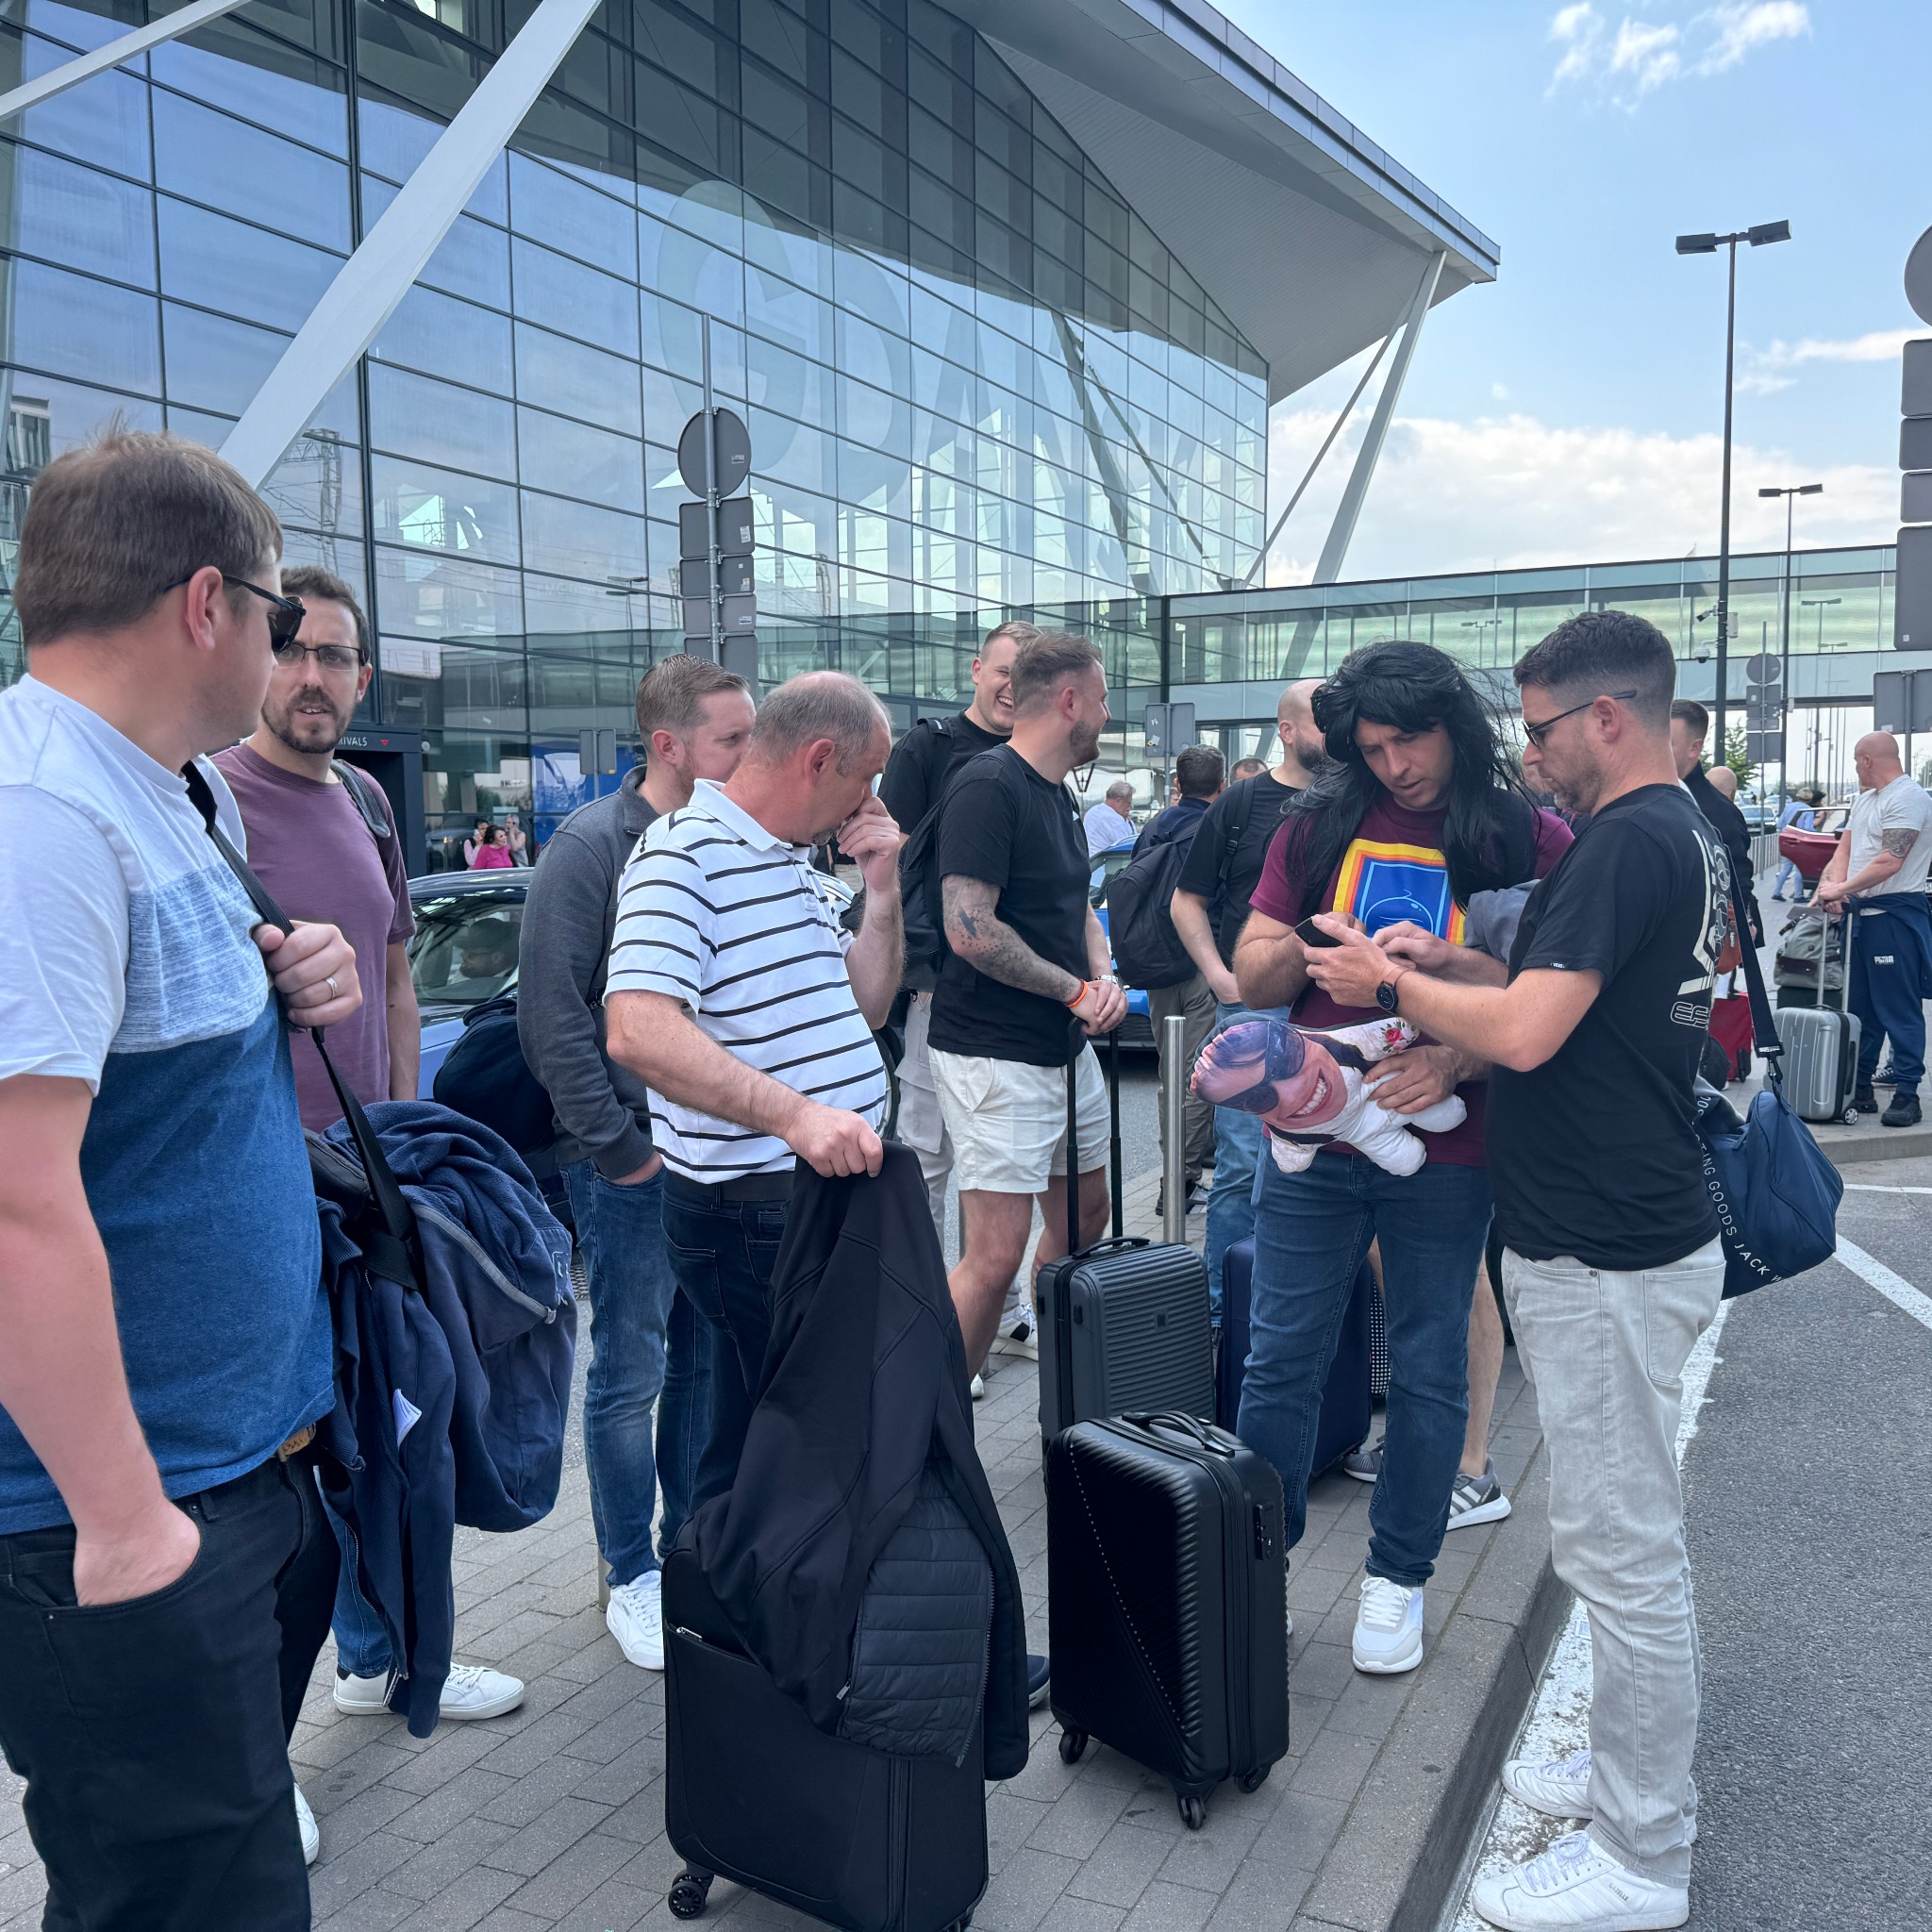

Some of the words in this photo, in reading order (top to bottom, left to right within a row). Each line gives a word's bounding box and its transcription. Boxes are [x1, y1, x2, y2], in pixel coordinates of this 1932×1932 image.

[1694, 1134, 1716, 1175] TING
[1708, 1181, 1738, 1237] GOODS
[1734, 1242, 1771, 1275] JACK
